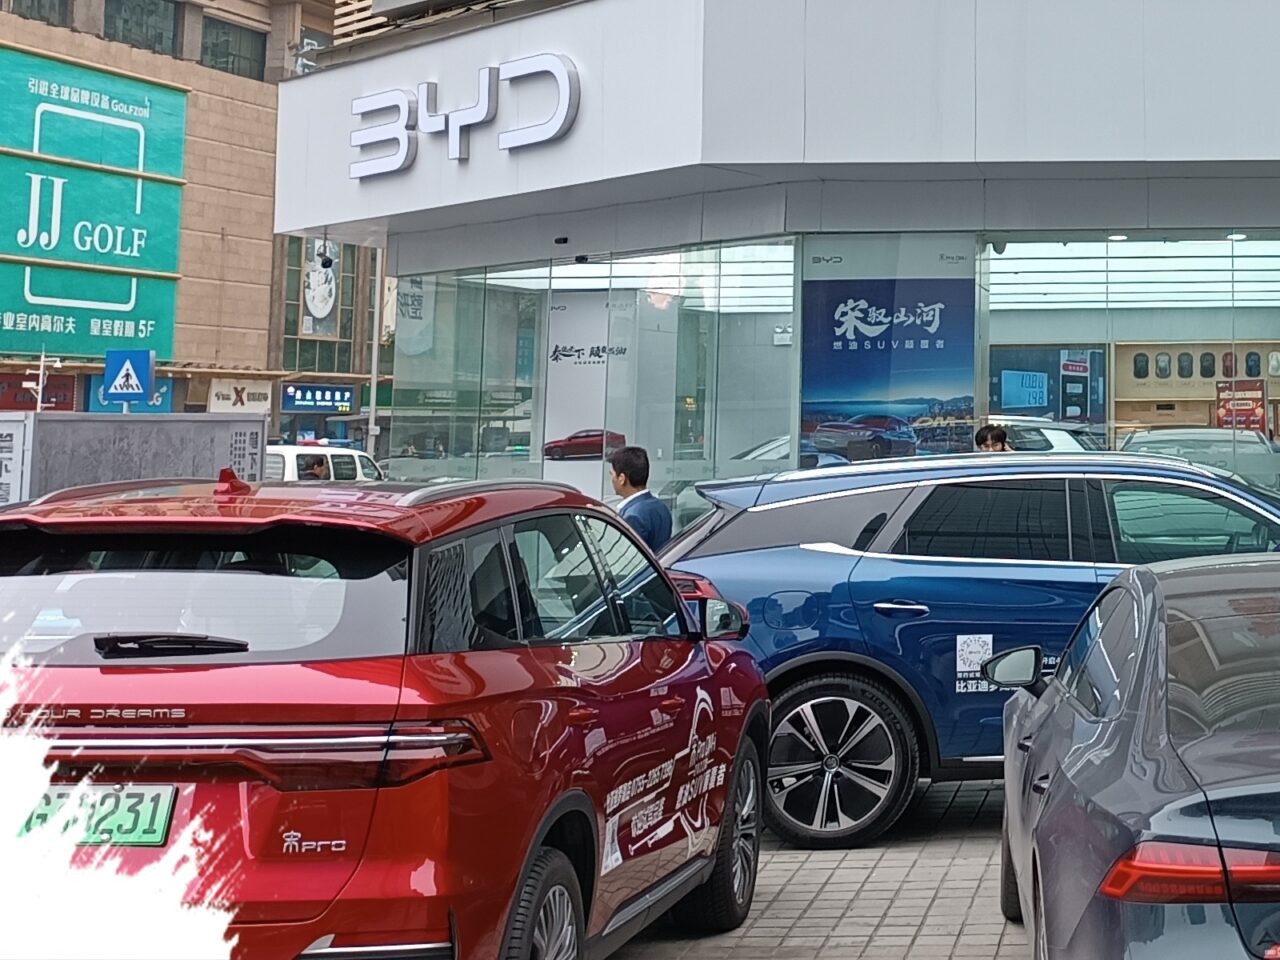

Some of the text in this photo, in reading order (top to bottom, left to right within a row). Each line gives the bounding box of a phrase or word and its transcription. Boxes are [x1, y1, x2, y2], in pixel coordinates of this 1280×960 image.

[350, 52, 581, 180] BYD
[16, 172, 148, 257] JJ GOLF
[811, 256, 844, 264] BYD
[138, 320, 156, 338] 5F
[833, 298, 946, 340] 宋驭山河
[90, 708, 186, 719] DREAMS
